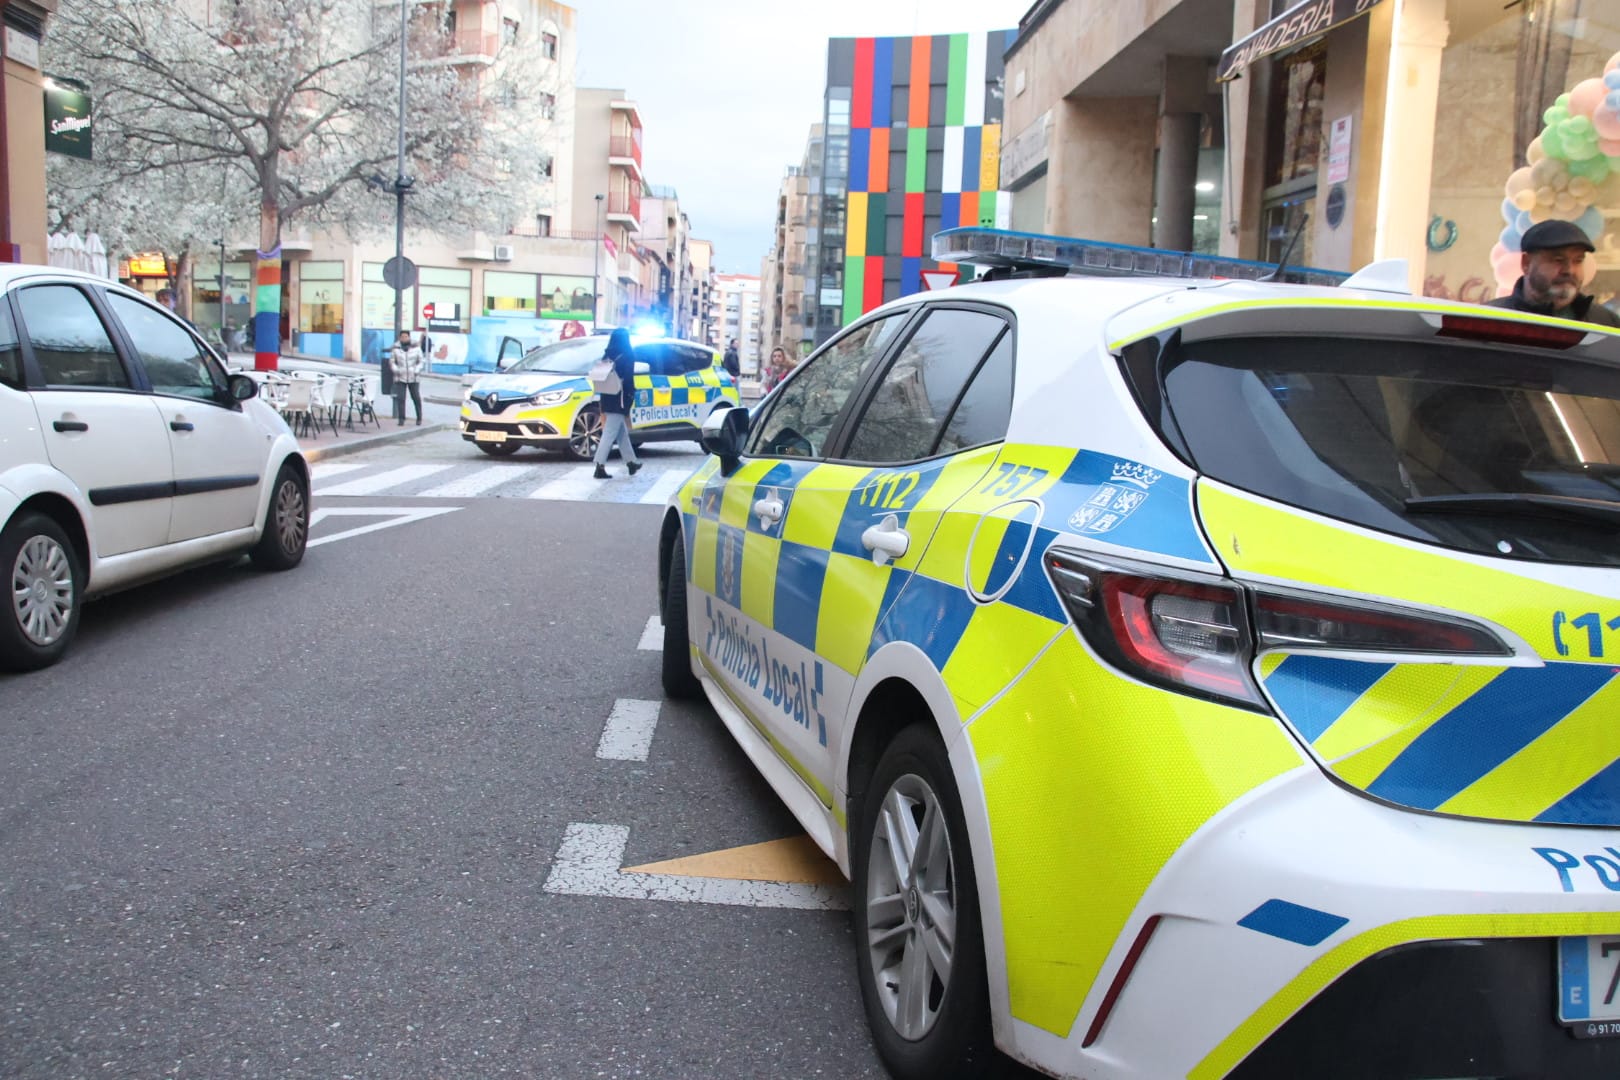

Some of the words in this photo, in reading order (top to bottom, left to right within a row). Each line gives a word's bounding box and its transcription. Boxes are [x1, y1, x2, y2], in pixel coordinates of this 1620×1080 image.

[870, 471, 920, 509] 112
[980, 462, 1049, 498] 757
[715, 609, 761, 690] Policía
[761, 636, 810, 730] Local
